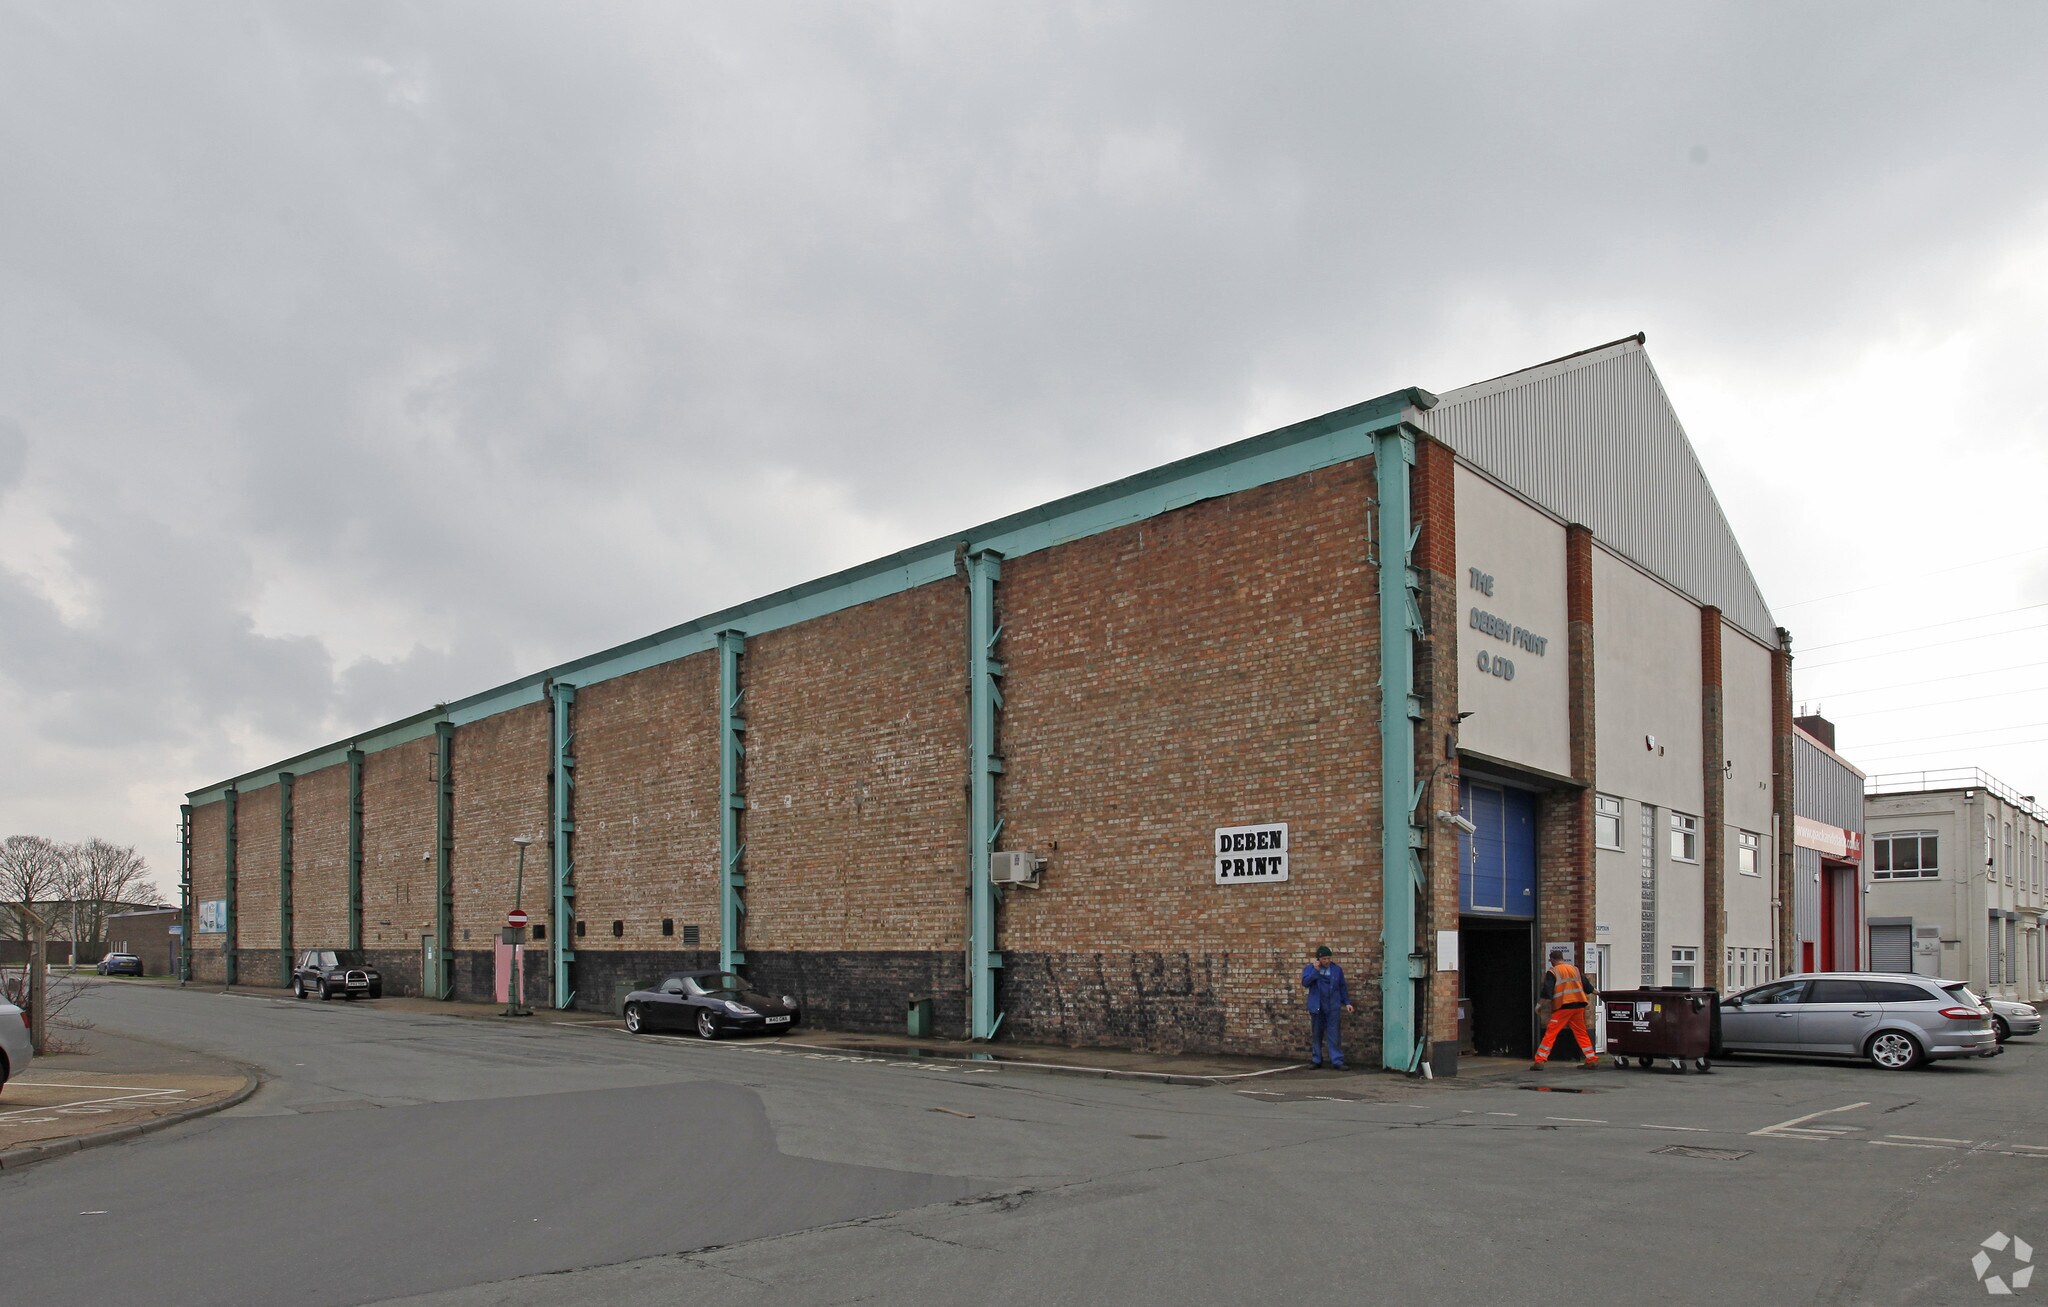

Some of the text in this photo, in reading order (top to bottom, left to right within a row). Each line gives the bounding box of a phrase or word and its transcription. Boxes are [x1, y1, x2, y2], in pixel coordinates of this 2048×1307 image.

[1469, 567, 1494, 597] THE
[1470, 607, 1548, 657] DEBEN PRINT
[1492, 655, 1515, 681] LTD
[1220, 830, 1282, 852] DEBEN
[1221, 856, 1282, 877] PRINT
